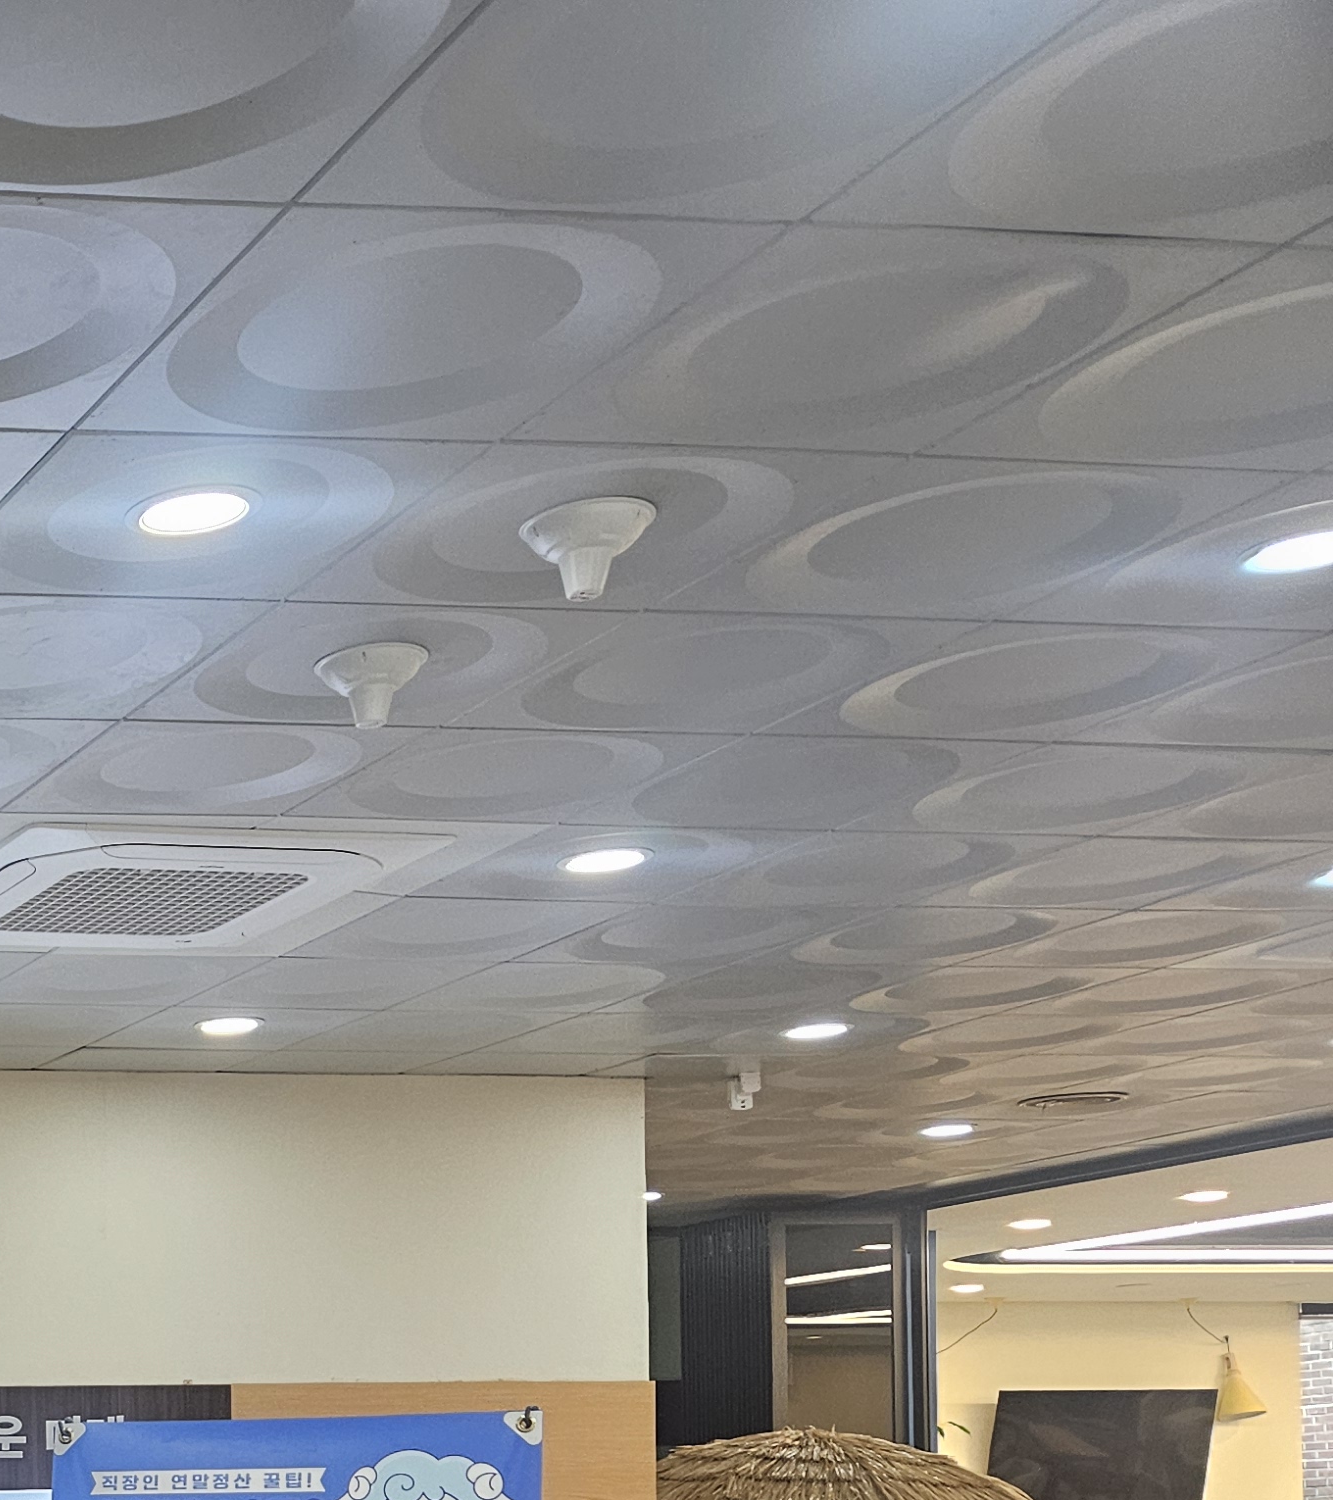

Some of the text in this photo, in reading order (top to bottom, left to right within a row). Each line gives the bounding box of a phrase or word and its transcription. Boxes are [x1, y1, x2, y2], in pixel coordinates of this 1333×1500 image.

[102, 1472, 313, 1491] 직장인 연말정산 꿀팁!
